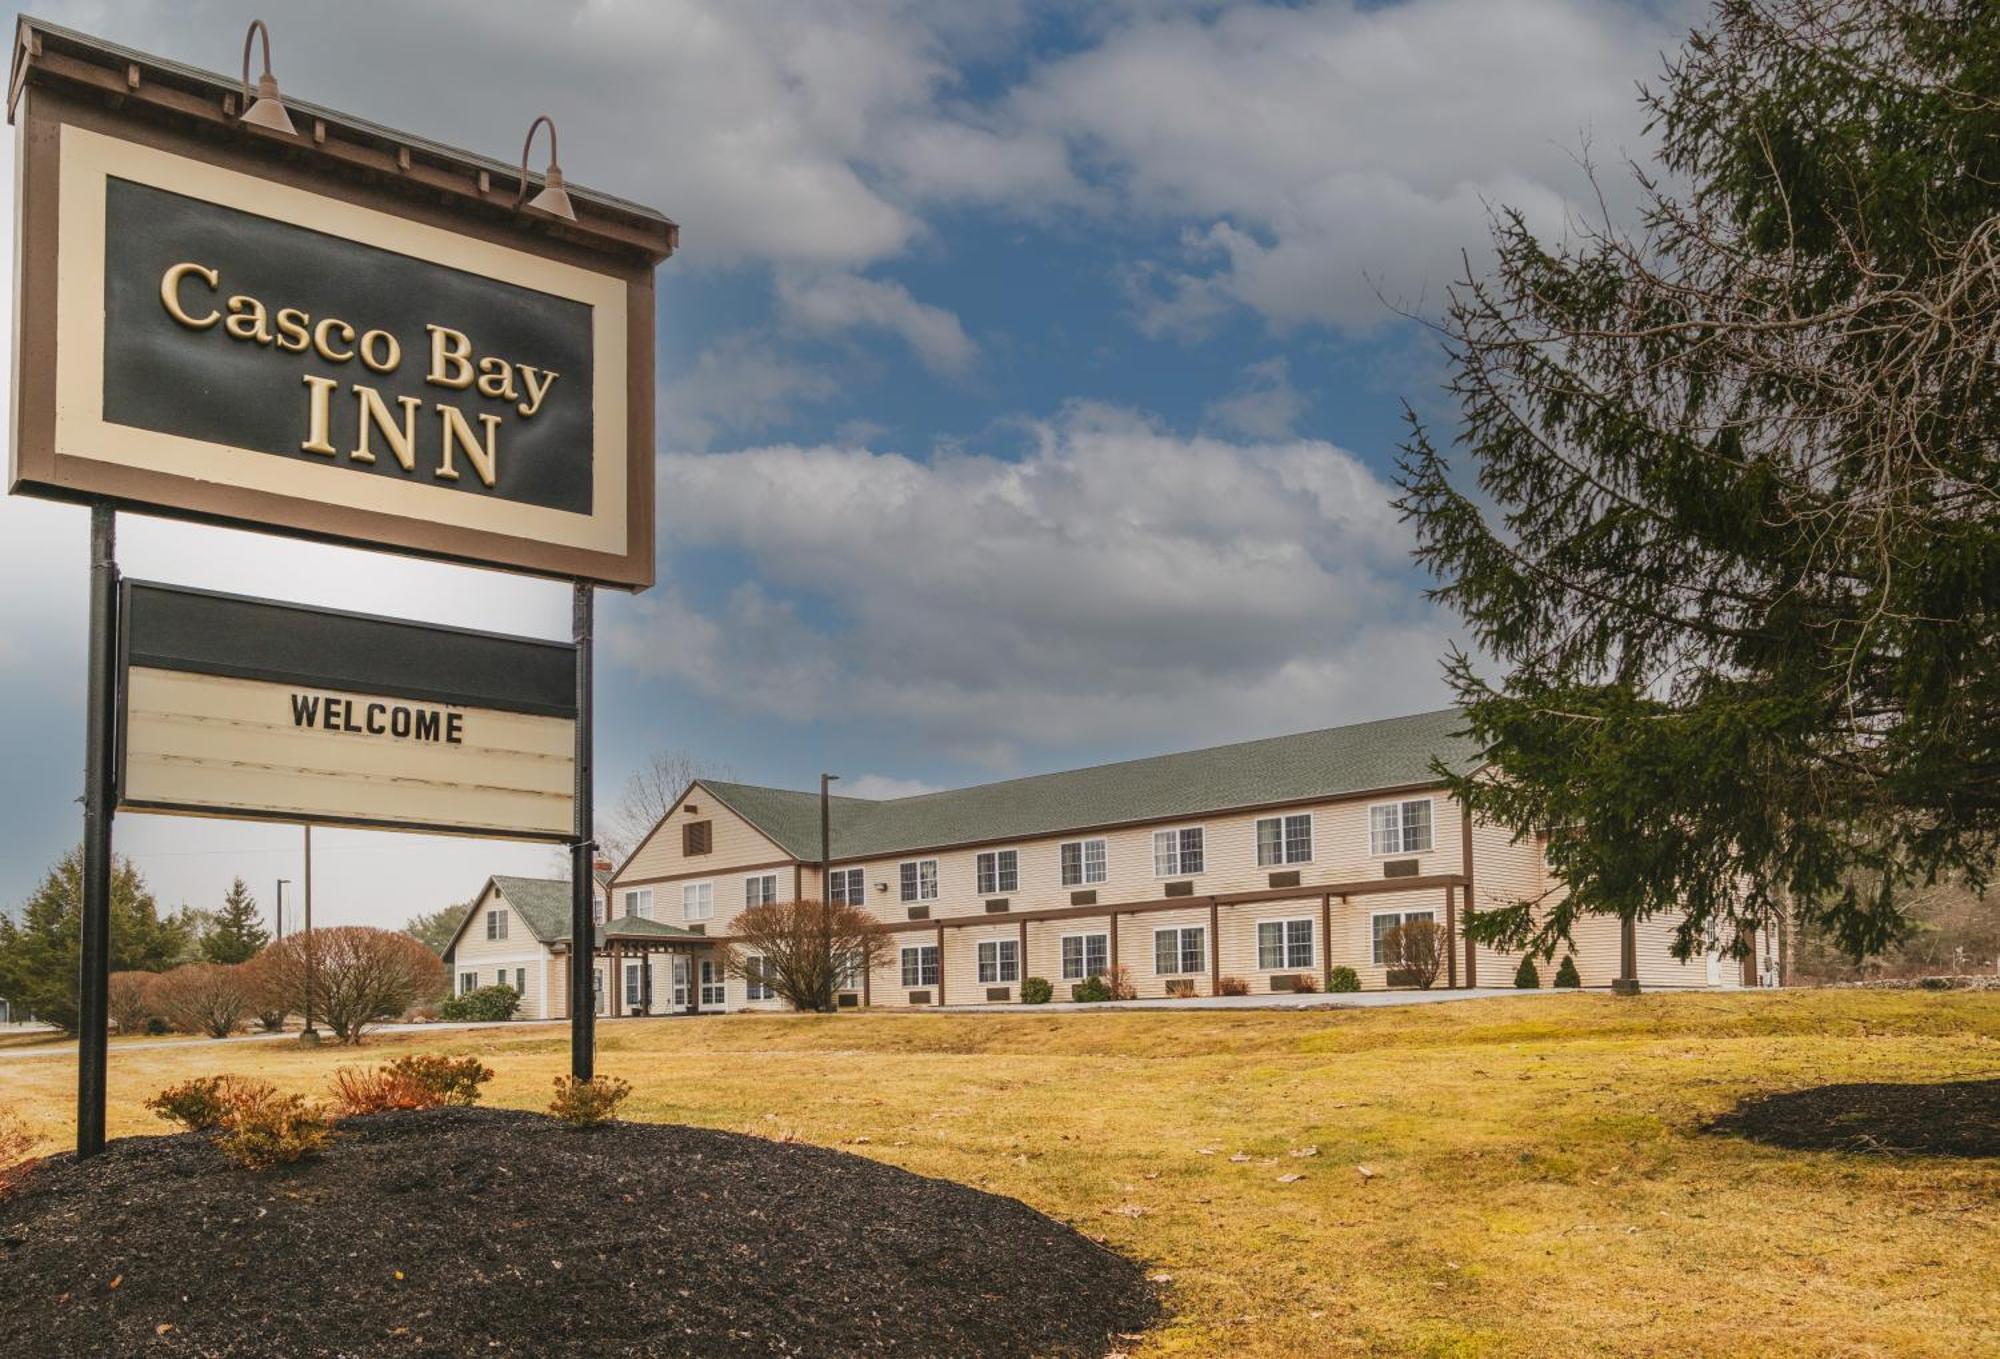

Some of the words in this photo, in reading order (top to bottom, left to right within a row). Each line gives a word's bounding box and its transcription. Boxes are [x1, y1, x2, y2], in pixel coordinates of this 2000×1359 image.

[160, 262, 401, 373] Casco
[425, 323, 560, 417] Bay
[301, 374, 502, 487] INN
[291, 694, 463, 744] WELCOME
